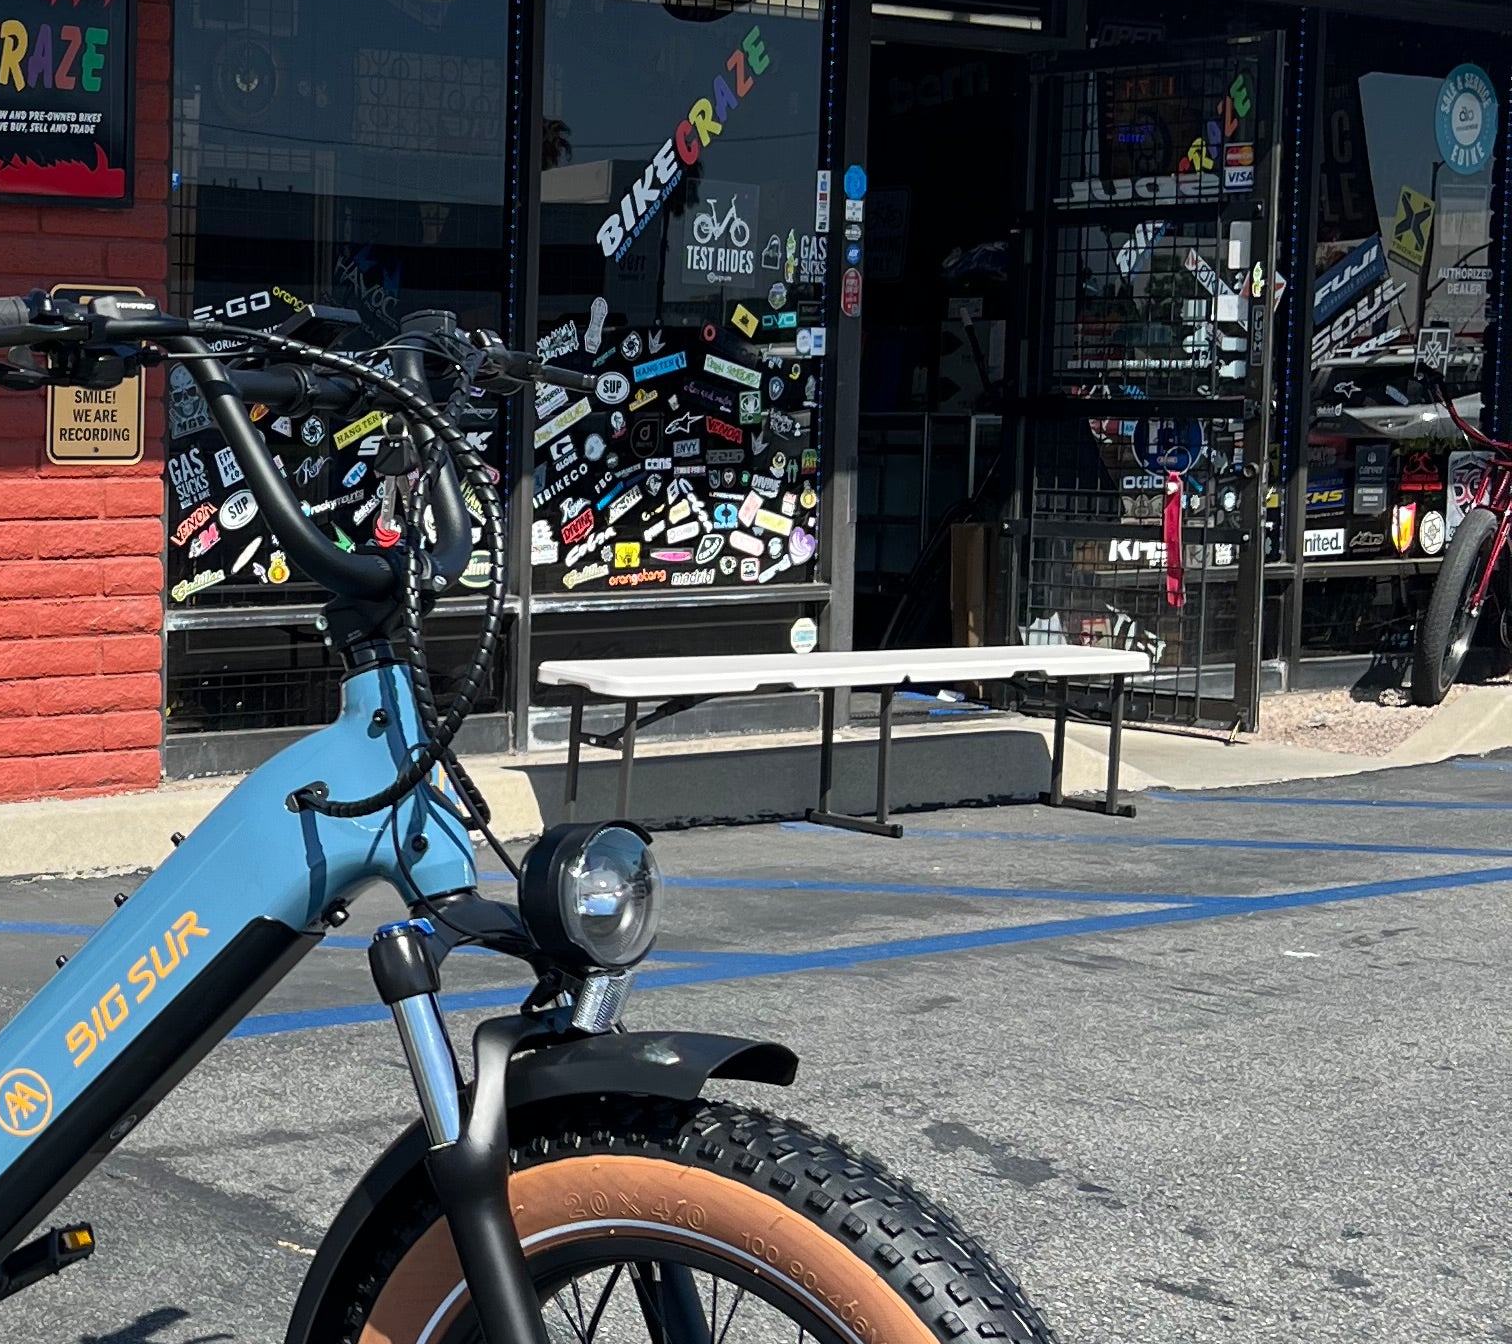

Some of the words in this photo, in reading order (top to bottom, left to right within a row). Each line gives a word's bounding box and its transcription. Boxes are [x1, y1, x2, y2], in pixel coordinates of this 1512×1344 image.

[1464, 72, 1492, 109] SERVICE
[9, 110, 26, 120] AND
[28, 111, 77, 122] PRE-OWNED
[79, 112, 102, 123] BIKES
[29, 123, 48, 133] SELL
[50, 123, 67, 133] AND
[69, 124, 95, 135] TRADE
[596, 138, 678, 257] BIKE
[675, 25, 770, 165] CRAZE
[1228, 170, 1254, 183] VISA
[800, 235, 827, 261] GAS
[687, 245, 714, 270] TEST
[717, 247, 753, 274] RIDES
[800, 260, 827, 275] SUCKS
[1313, 243, 1378, 308] FUJI
[1438, 267, 1493, 281] AUTHORIZED
[1447, 283, 1482, 295] DEALER
[635, 364, 658, 377] HANG
[660, 359, 675, 370] TEN
[603, 379, 622, 393] SUP
[75, 390, 116, 404] SMILE!
[73, 409, 91, 422] WE
[93, 409, 117, 422] ARE
[59, 427, 130, 441] RECORDING
[168, 447, 205, 486] GAS
[176, 473, 209, 501] SUCKS
[532, 463, 588, 509] ITBIKECO
[227, 496, 249, 520] SUP
[1304, 532, 1342, 553] nited.
[65, 984, 129, 1068] BIG
[126, 911, 209, 1004] SUR
